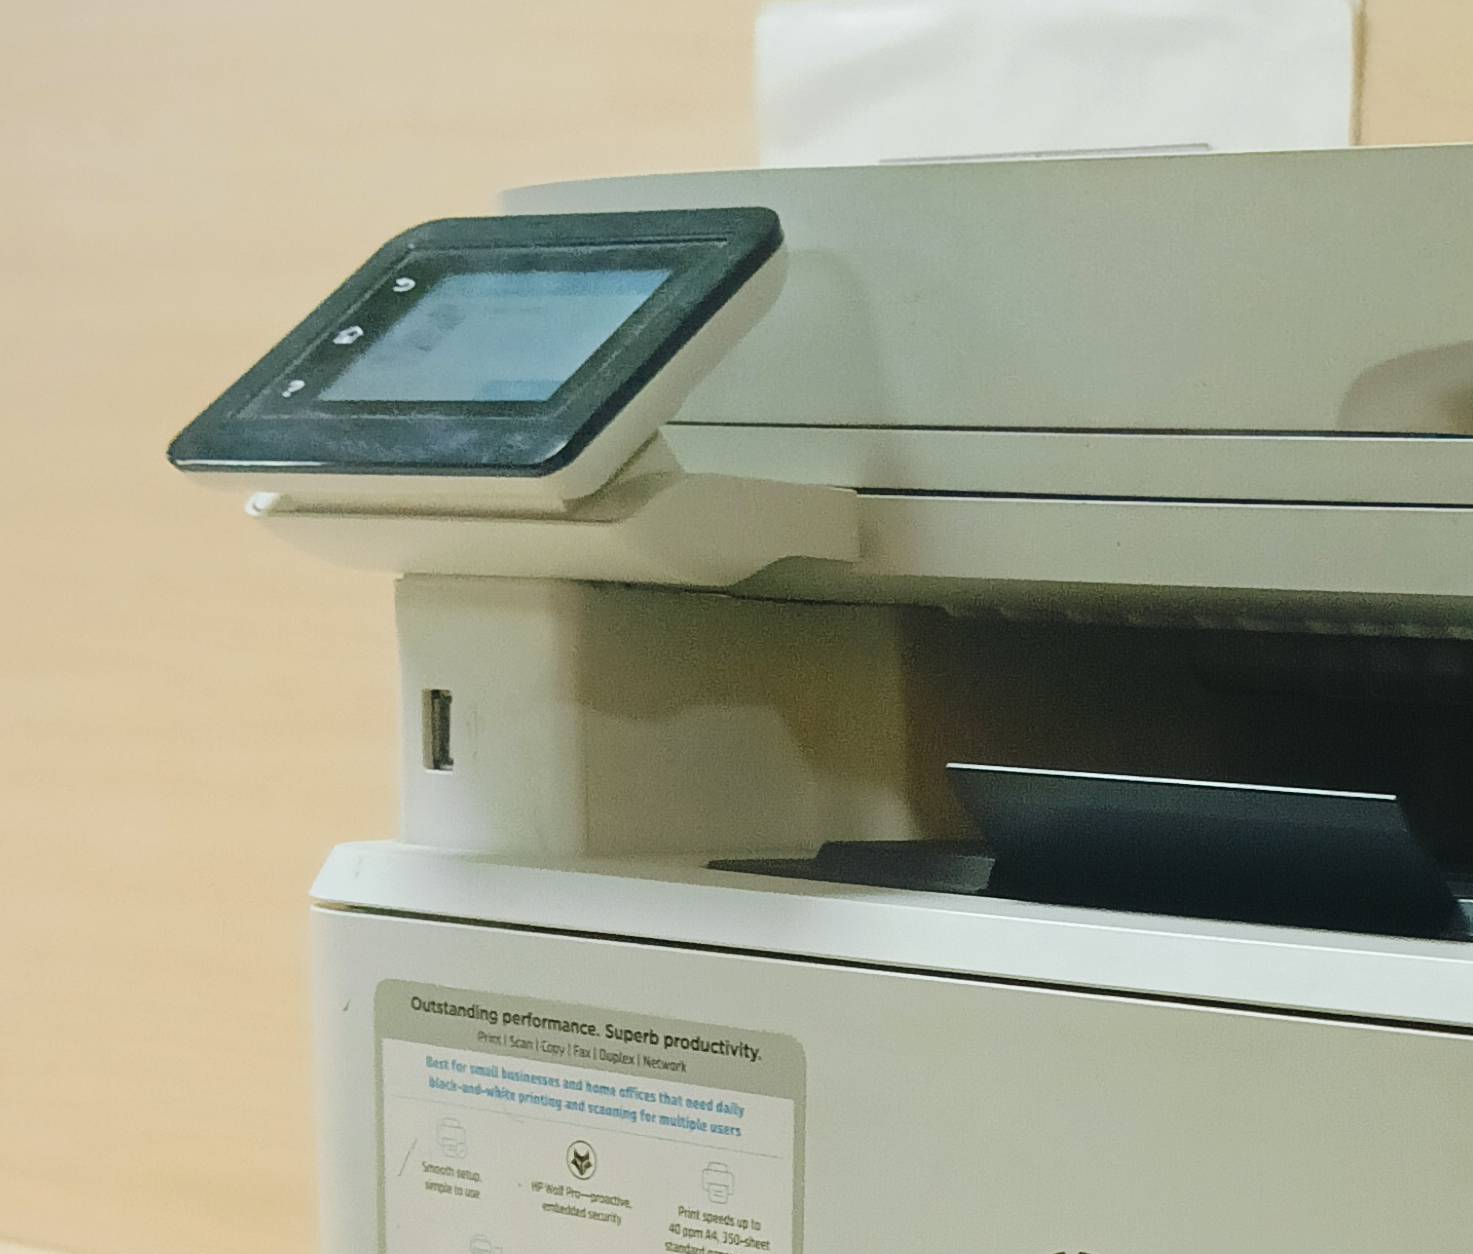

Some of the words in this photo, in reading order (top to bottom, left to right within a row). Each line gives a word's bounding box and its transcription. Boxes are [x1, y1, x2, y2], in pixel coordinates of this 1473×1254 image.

[411, 996, 498, 1024] Outstanding
[502, 1012, 600, 1036] performance.
[605, 1024, 659, 1045] Superb
[664, 1034, 762, 1062] productivity.
[477, 1030, 501, 1043] Print
[510, 1036, 533, 1049] Scan
[541, 1039, 565, 1056] Copy
[573, 1045, 590, 1058] Fax
[600, 1050, 635, 1066] Duplex
[643, 1057, 687, 1072] Network
[426, 1056, 448, 1069] Best
[451, 1059, 467, 1072] for
[470, 1064, 499, 1078] small
[502, 1068, 561, 1087] businesses
[563, 1078, 583, 1091] and
[586, 1081, 616, 1097] home
[619, 1086, 657, 1103] offices
[659, 1092, 683, 1106] that
[686, 1098, 713, 1112] need
[716, 1102, 745, 1118] daily
[428, 1077, 515, 1100] black-and-white
[518, 1094, 562, 1111] printing
[565, 1099, 585, 1112] and
[588, 1102, 637, 1123] scanning
[640, 1109, 656, 1123] for
[659, 1115, 707, 1132] multiple
[710, 1124, 741, 1136] users
[542, 1202, 586, 1218] embedded
[588, 1210, 622, 1226] security
[668, 1223, 681, 1235] 40
[683, 1227, 703, 1239] ppm
[678, 1205, 700, 1220] Print
[702, 1212, 735, 1227] speeds
[737, 1219, 749, 1231] up
[751, 1218, 762, 1231] to
